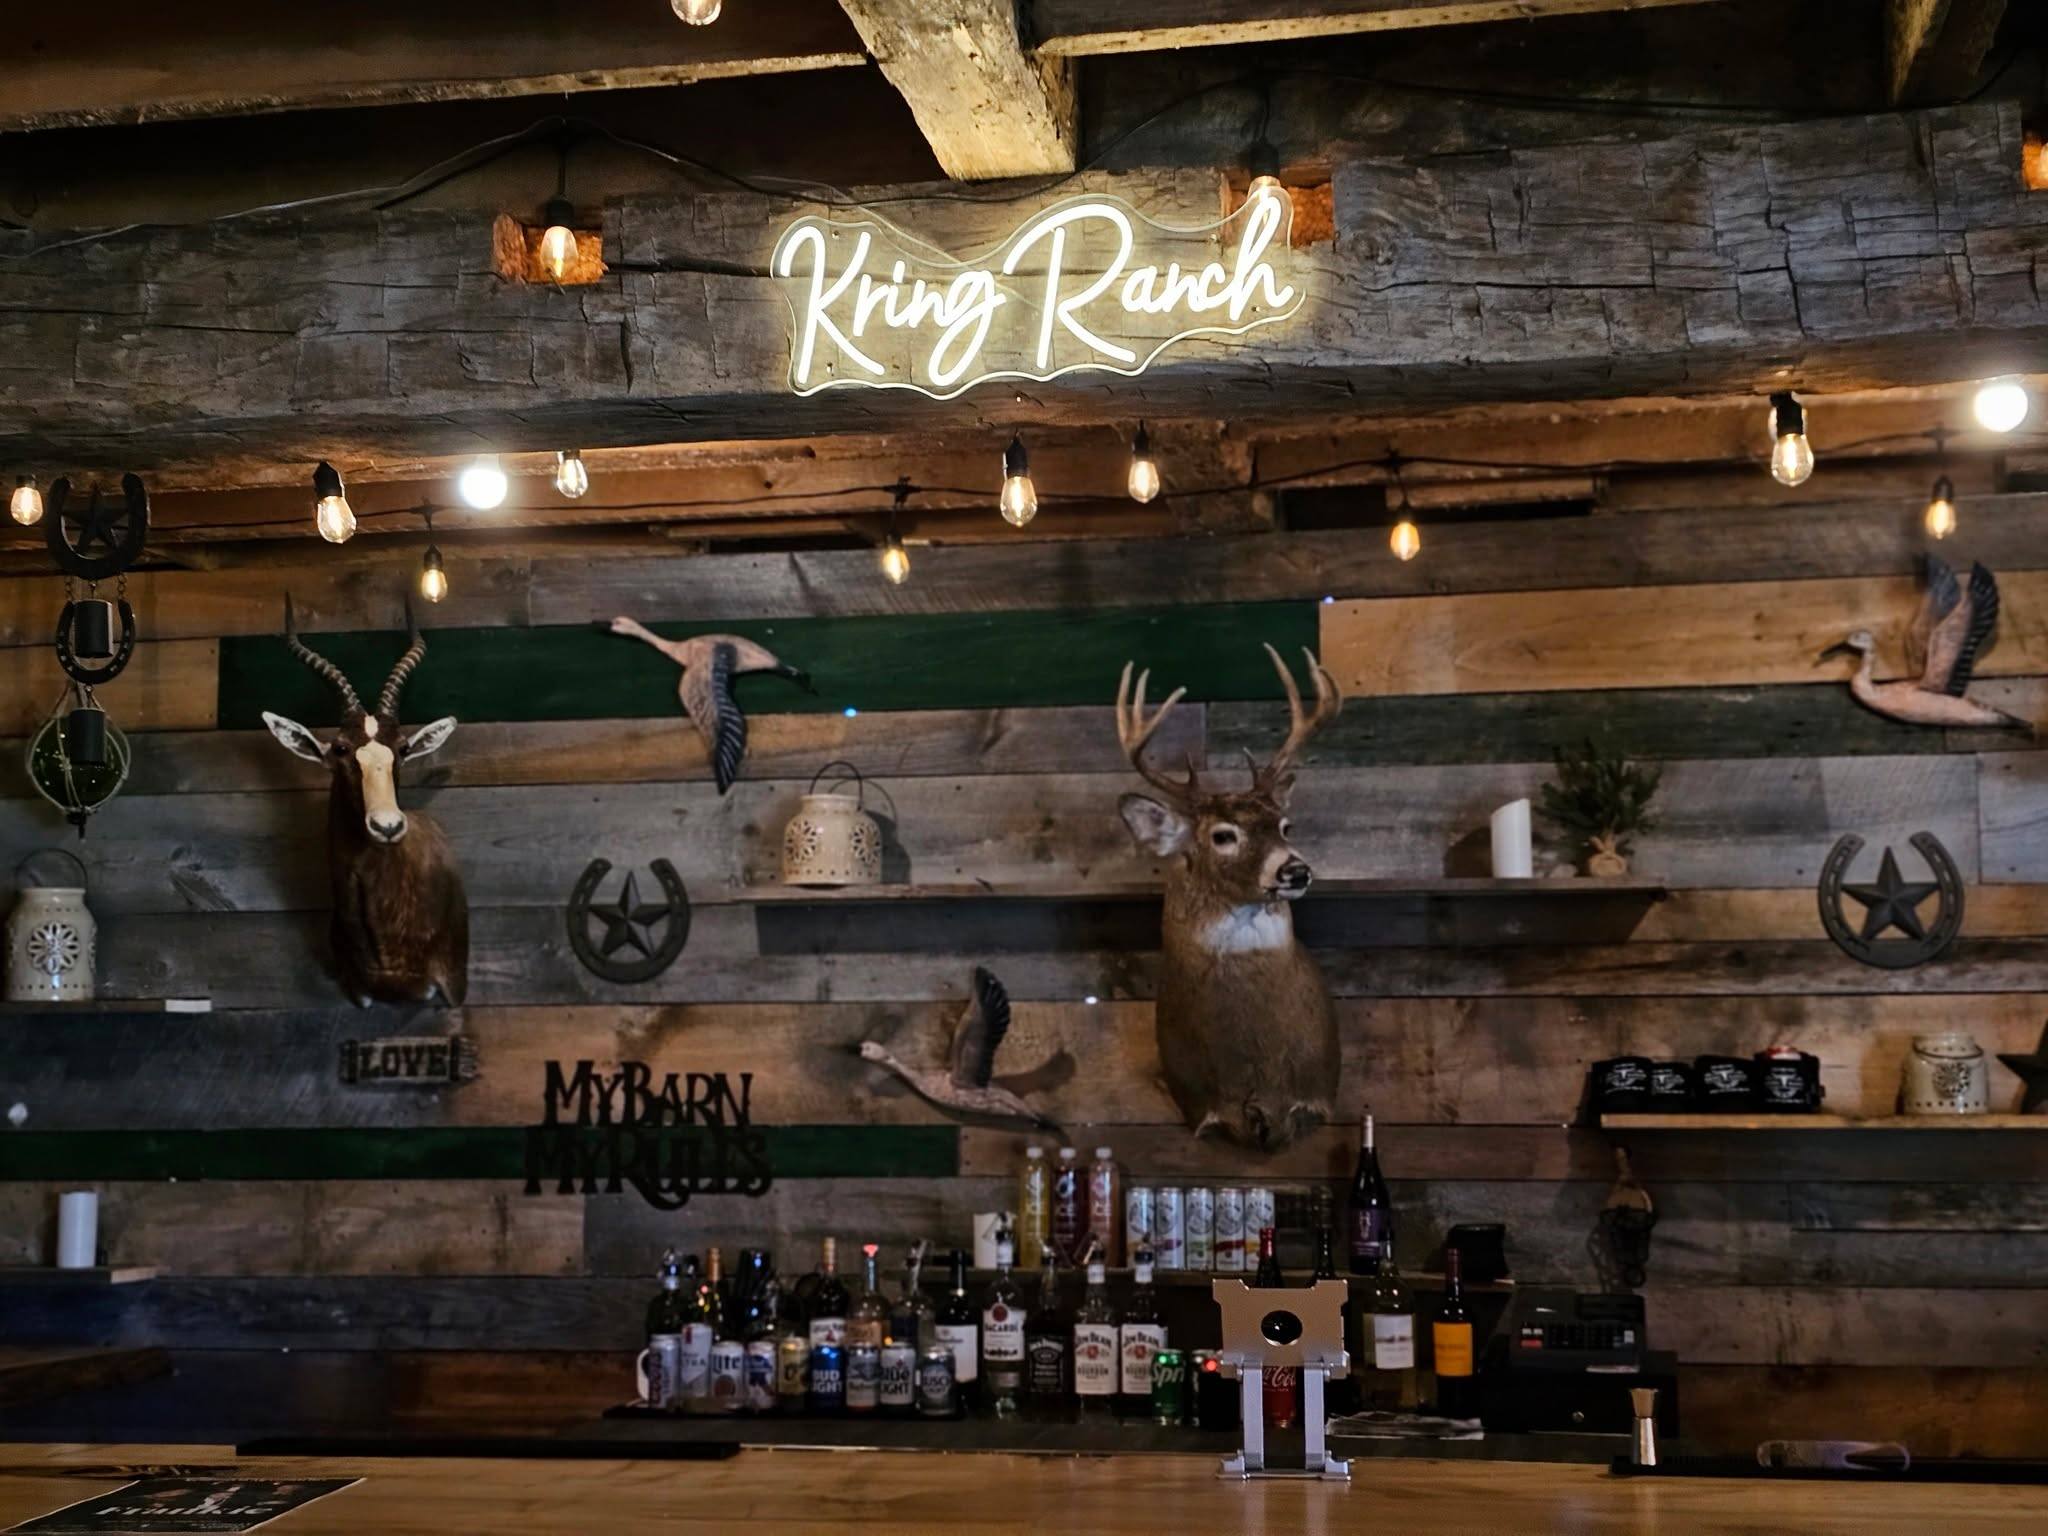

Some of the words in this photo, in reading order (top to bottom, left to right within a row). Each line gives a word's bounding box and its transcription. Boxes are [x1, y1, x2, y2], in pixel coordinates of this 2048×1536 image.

[779, 224, 1007, 387] Kring
[1002, 195, 1295, 370] Ranch
[358, 1045, 450, 1078] LOVE
